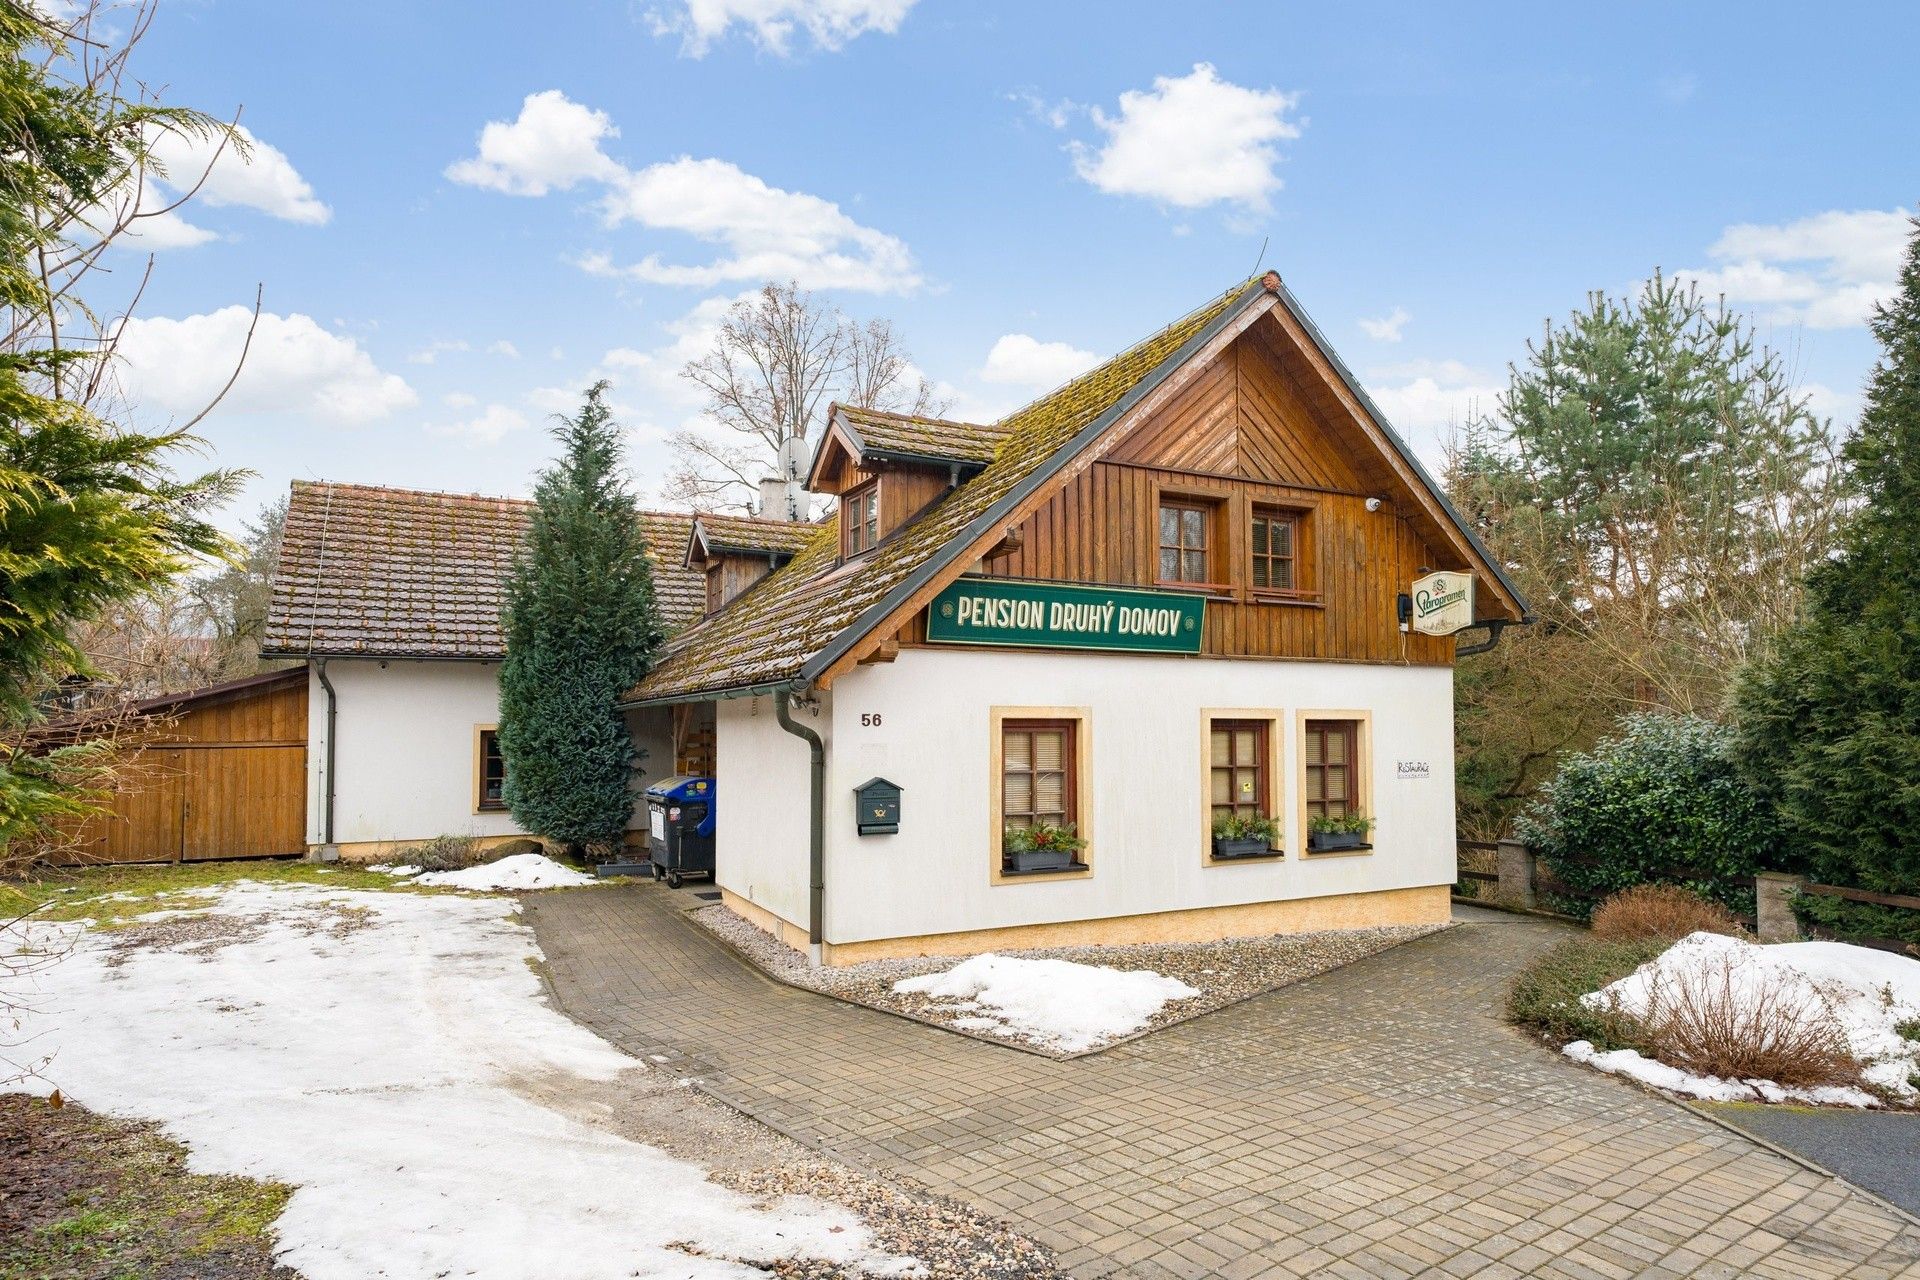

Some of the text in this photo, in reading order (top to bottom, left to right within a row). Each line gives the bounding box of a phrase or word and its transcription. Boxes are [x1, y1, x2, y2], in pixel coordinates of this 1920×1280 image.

[957, 596, 1181, 637] PENSION DRUHÝ DOMOV
[1416, 590, 1466, 618] Staropramen
[861, 713, 882, 727] 56
